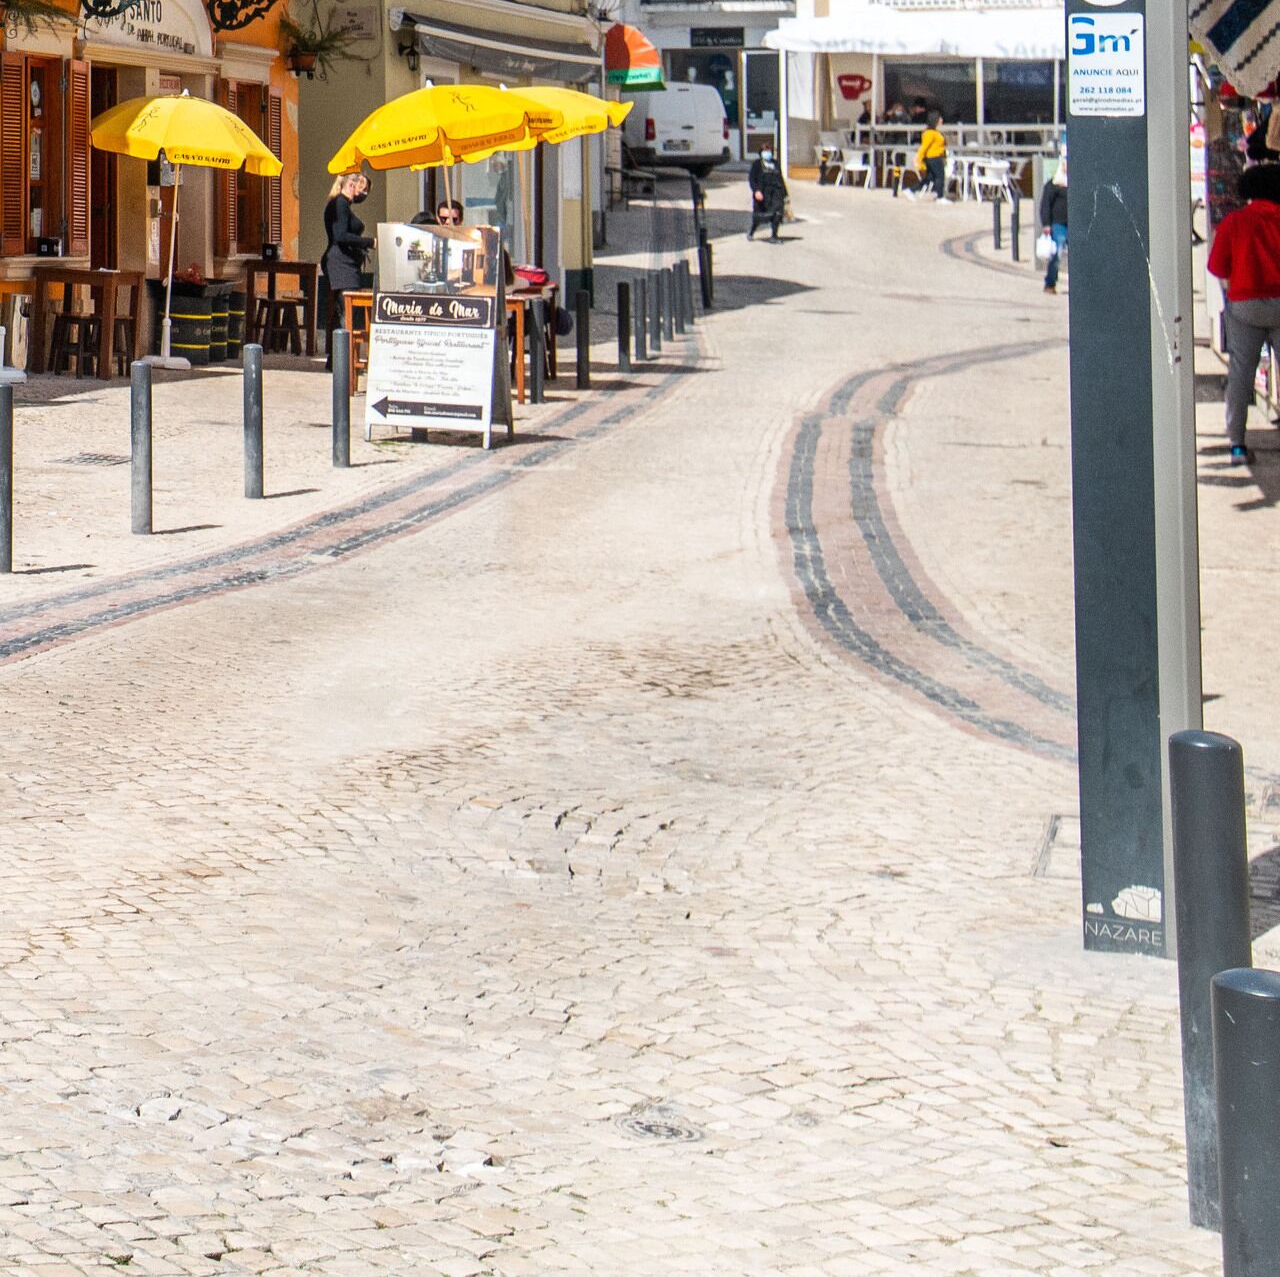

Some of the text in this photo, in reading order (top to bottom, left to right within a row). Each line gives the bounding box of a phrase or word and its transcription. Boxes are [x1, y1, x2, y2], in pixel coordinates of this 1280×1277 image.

[1073, 68, 1139, 76] ANUNCIE AQUI
[1080, 86, 1132, 94] 262 118 084
[382, 297, 480, 319] Maria do Mar
